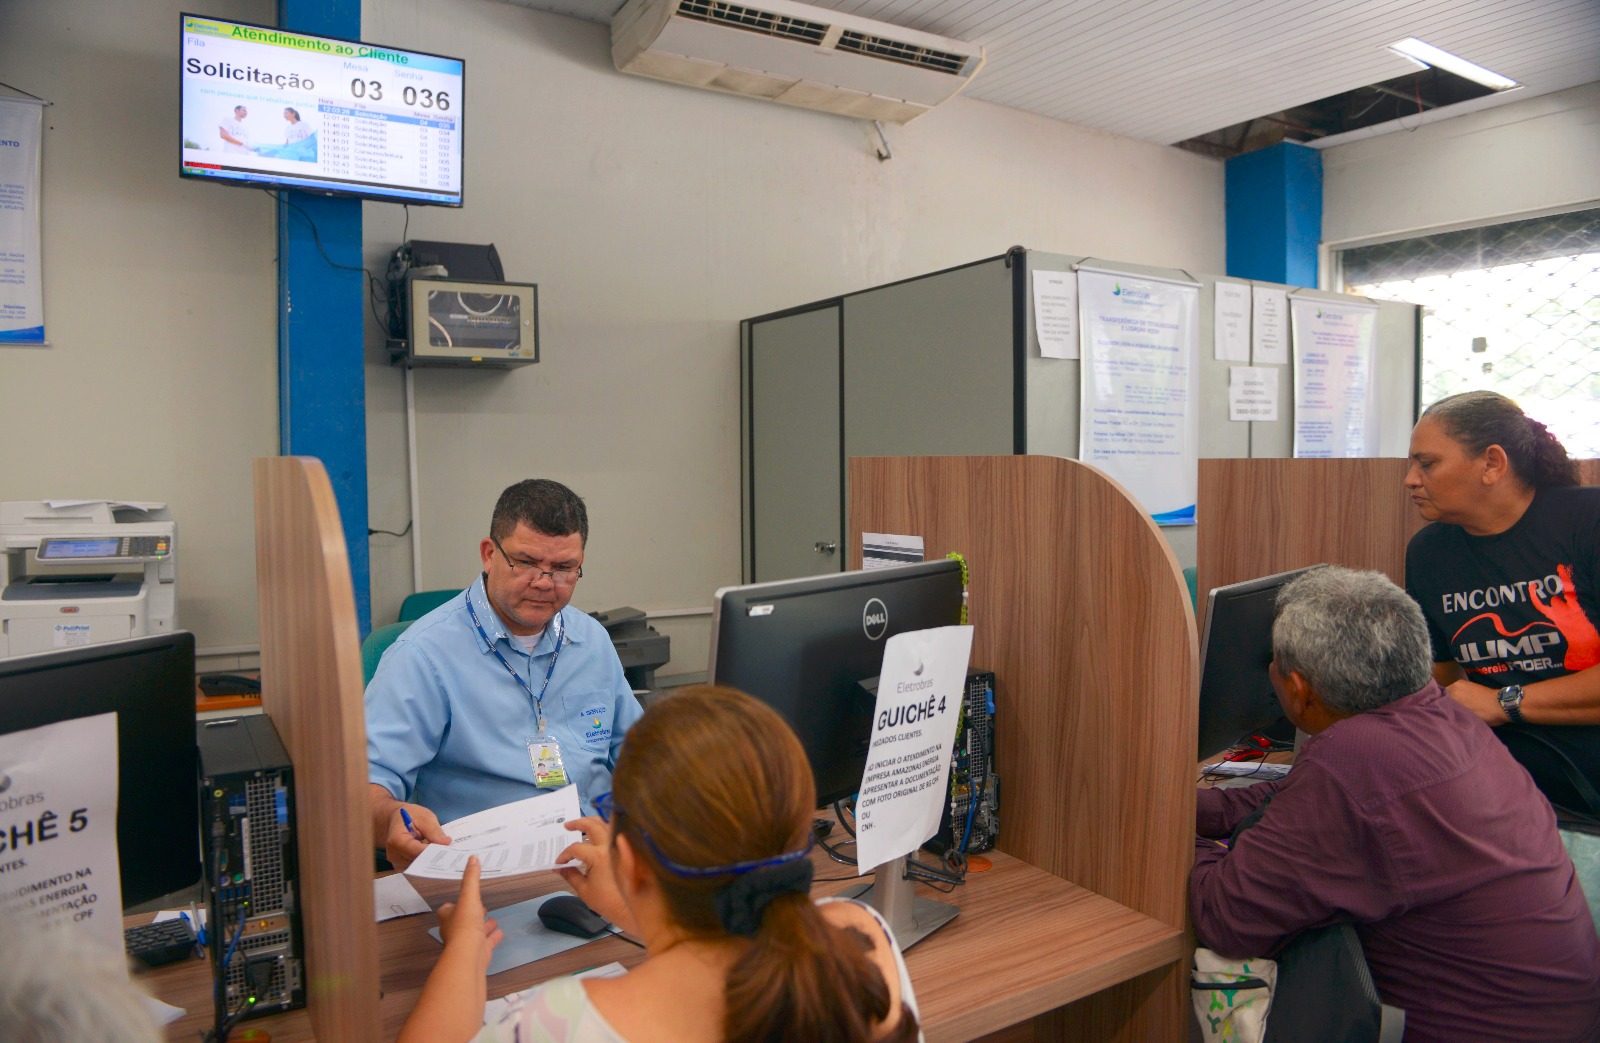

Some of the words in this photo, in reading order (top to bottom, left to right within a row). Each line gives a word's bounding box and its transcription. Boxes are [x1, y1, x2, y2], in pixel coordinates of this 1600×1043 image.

[187, 37, 206, 47] Fila
[231, 25, 330, 52] Atendimento
[336, 45, 354, 55] ao
[358, 46, 409, 65] Cliente
[186, 58, 315, 90] Solicitação
[343, 61, 369, 72] Mesa
[394, 69, 423, 80] Senha
[350, 78, 383, 101] 03
[402, 86, 450, 111] 036
[1442, 574, 1564, 614] ENCONTRO
[865, 612, 886, 626] DELL
[1454, 631, 1561, 663] JUMP
[896, 678, 934, 693] Eletrobras
[877, 693, 936, 731] GUICHÊ
[937, 695, 947, 714] 4
[874, 757, 896, 770] INICIAR
[896, 756, 902, 764] O
[902, 745, 935, 763] ATENDIMENTO
[935, 743, 942, 751] NA
[891, 761, 922, 776] AMAZONAS
[863, 780, 899, 796] APRESENTAR
[898, 777, 904, 786] A
[904, 764, 941, 785] DOCUMENTAÇÃO
[861, 797, 876, 808] COM
[876, 793, 892, 803] FOTO
[892, 784, 918, 799] ORIGINAL
[918, 782, 925, 790] DE
[69, 807, 88, 833] 5
[861, 811, 871, 820] OU
[75, 867, 92, 879] NA
[39, 882, 88, 905] ENERGIA
[73, 908, 94, 922] CPF
